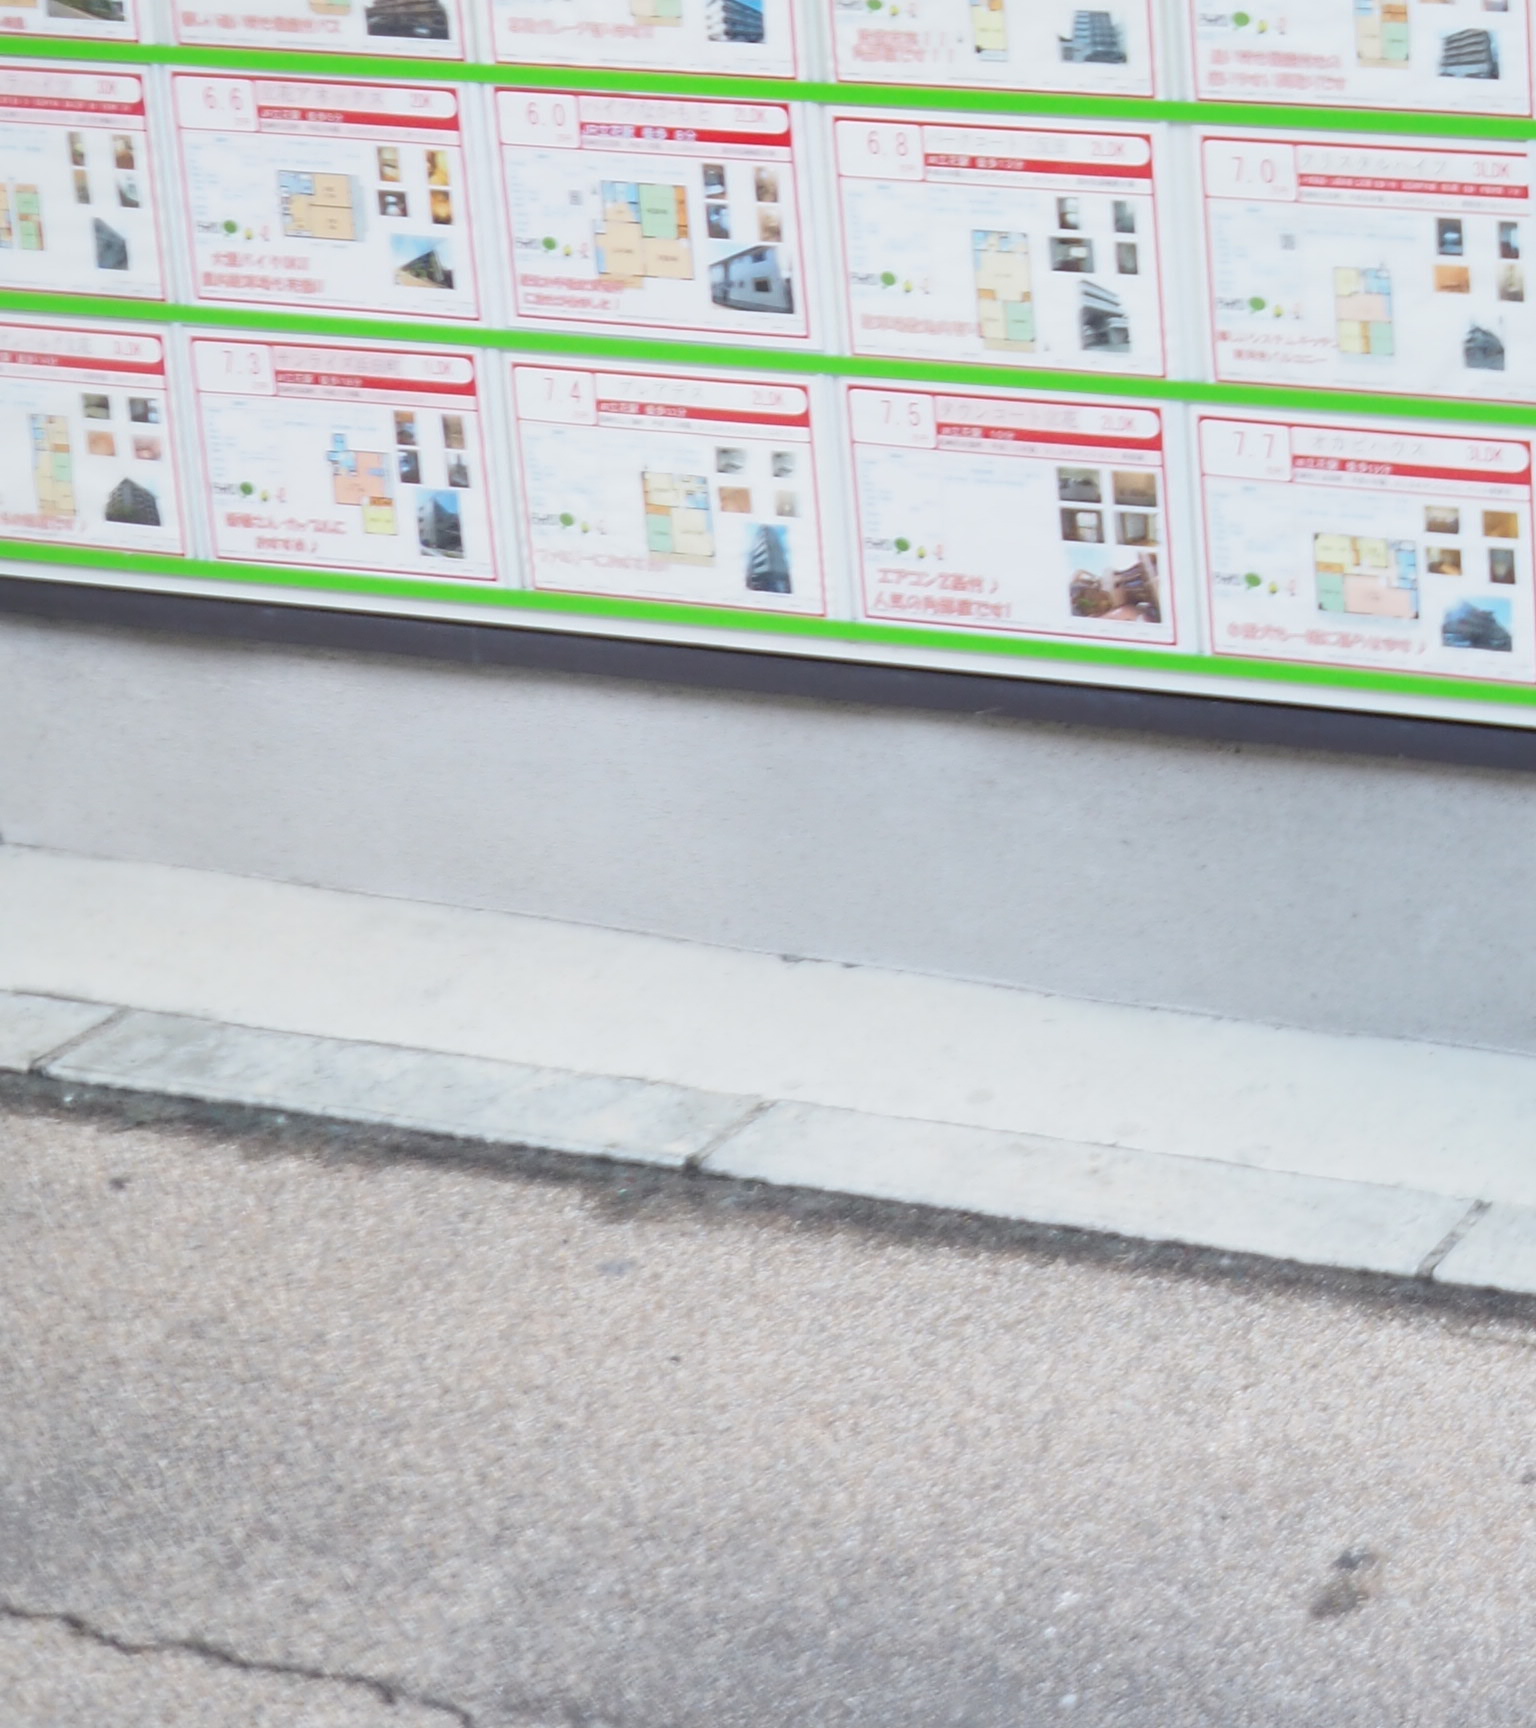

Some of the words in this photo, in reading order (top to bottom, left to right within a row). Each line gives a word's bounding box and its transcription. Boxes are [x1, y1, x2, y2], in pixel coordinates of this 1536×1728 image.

[1230, 155, 1277, 183] 7.0
[880, 399, 921, 427] 7.5
[1232, 430, 1276, 458] 7.7
